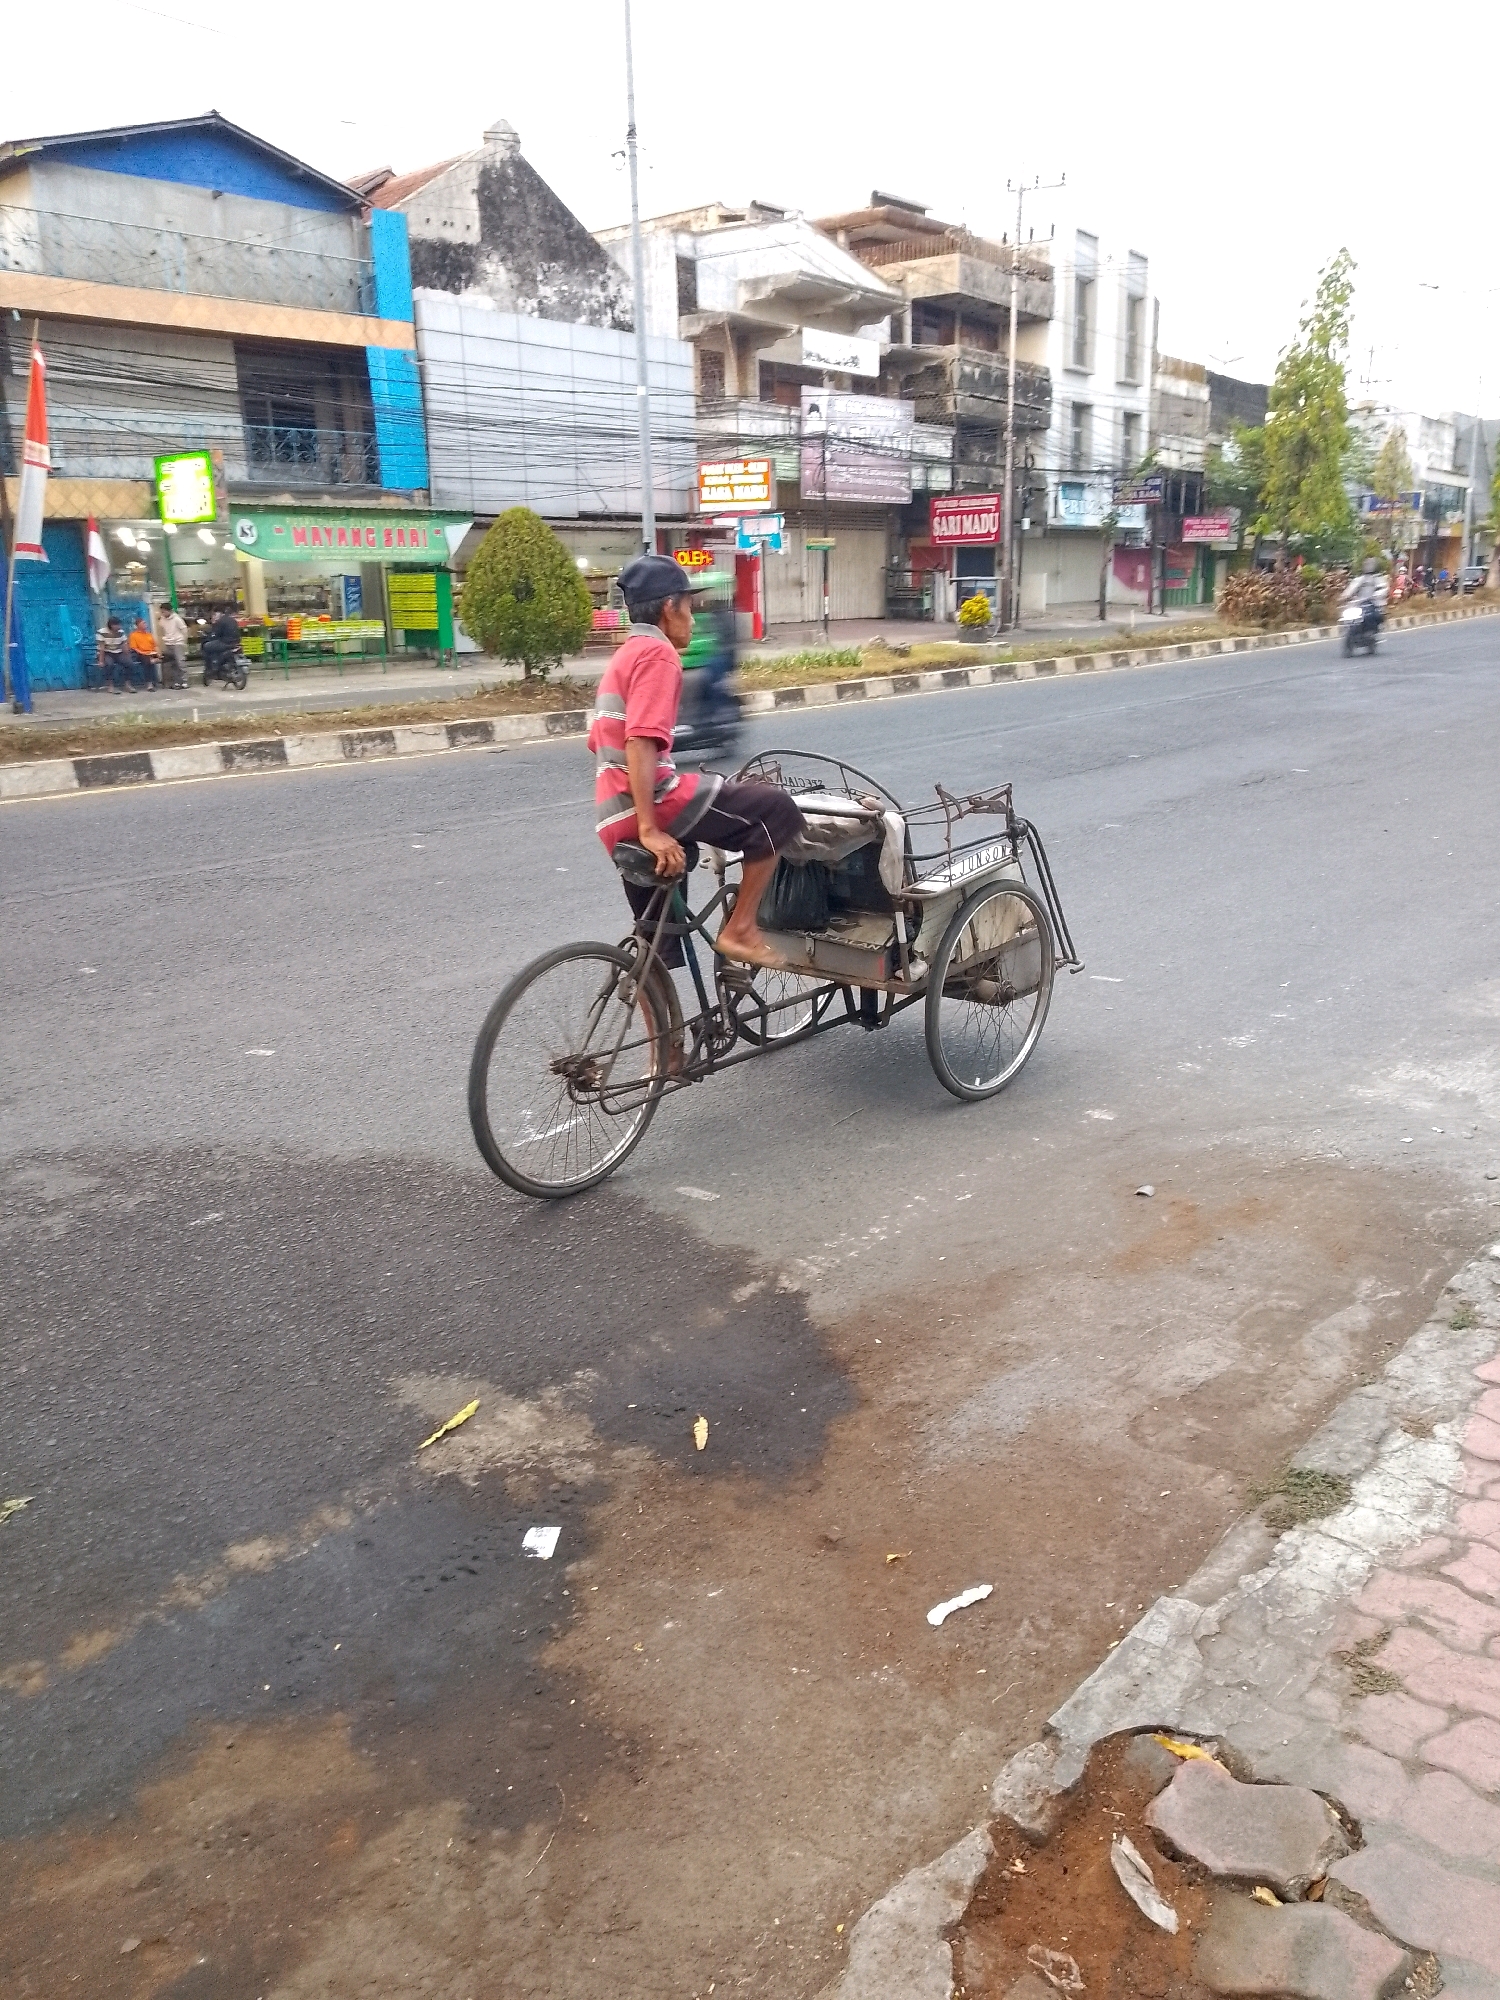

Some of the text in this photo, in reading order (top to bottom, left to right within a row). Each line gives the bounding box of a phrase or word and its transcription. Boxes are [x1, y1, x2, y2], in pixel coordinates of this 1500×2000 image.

[932, 512, 1000, 537] SARI MADU
[291, 526, 429, 549] MAYANG SARI
